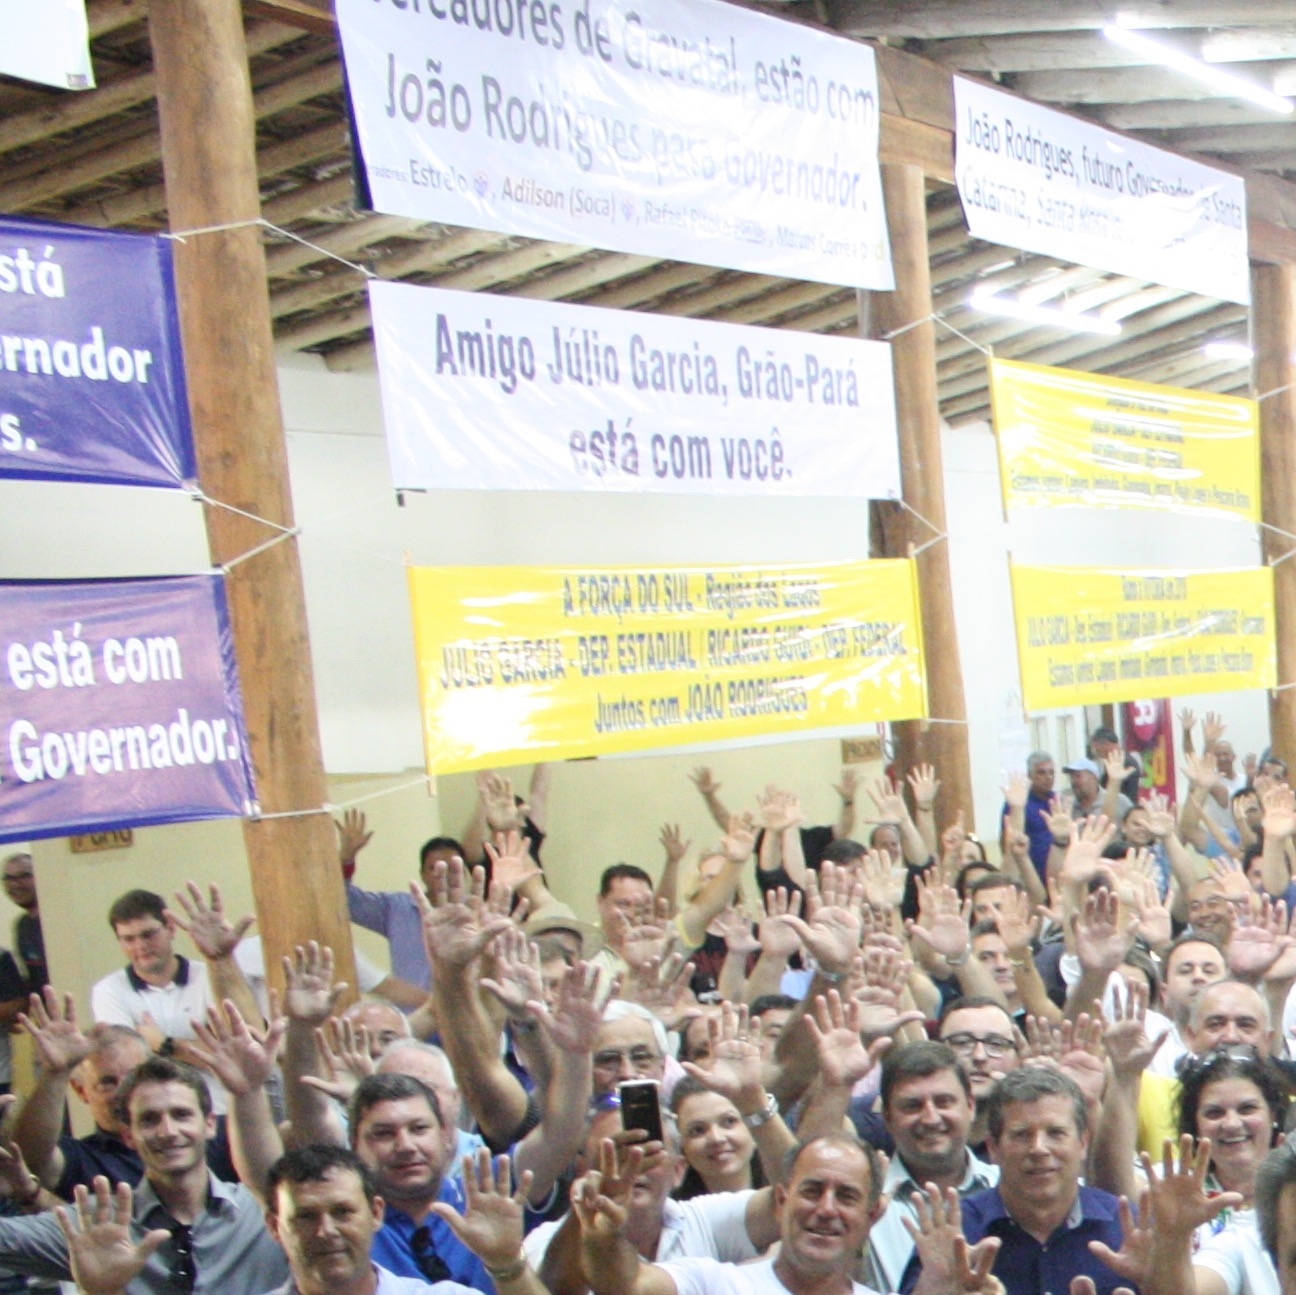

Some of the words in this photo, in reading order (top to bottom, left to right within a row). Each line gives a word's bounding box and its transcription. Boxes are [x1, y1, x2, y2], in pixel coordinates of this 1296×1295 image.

[573, 0, 617, 64] de
[754, 53, 820, 116] estão
[826, 79, 875, 129] com
[385, 52, 472, 133] João
[480, 73, 642, 172] Rodrigues
[652, 128, 718, 187] para
[724, 139, 869, 212] Governador.
[964, 104, 1001, 155] João
[1004, 117, 1080, 188] Rodrigues,
[1081, 144, 1124, 195] futuro
[500, 175, 565, 211] Adilson
[569, 185, 616, 223] (Soca)
[0, 245, 66, 298] stá
[435, 313, 537, 395] Amigo
[546, 323, 621, 389] Júlio
[630, 334, 730, 408] Garcia,
[736, 345, 861, 408] Grão-Pará
[569, 416, 640, 477] está
[651, 428, 712, 480] com
[721, 427, 794, 482] você.
[562, 576, 575, 618] A
[577, 574, 633, 625] FORÇA
[636, 573, 659, 614] DO
[663, 572, 694, 613] SUL
[7, 621, 97, 691] está
[102, 634, 184, 685] com
[577, 633, 613, 678] DEP.
[616, 630, 698, 675] ESTADUAL
[594, 692, 647, 734] Juntos
[649, 695, 682, 730] com
[684, 673, 725, 723] JOÃO
[8, 708, 238, 783] Governador.
